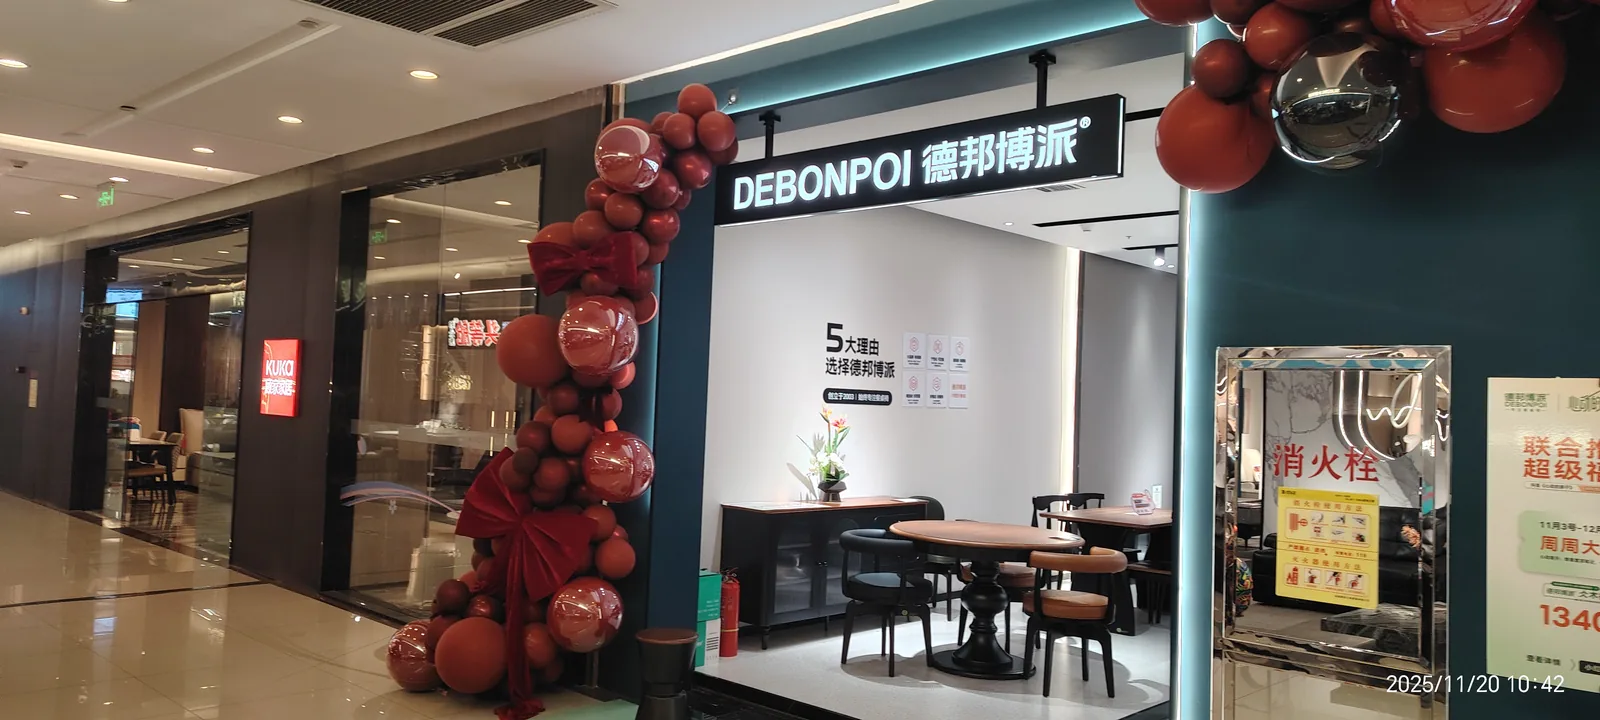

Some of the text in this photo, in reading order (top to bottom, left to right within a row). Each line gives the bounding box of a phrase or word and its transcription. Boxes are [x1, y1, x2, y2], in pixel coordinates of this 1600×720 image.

[733, 117, 1078, 210] DEBONPOI 德邦博派
[825, 357, 896, 379] 选择德邦博派
[1273, 443, 1380, 482] 消火栓
